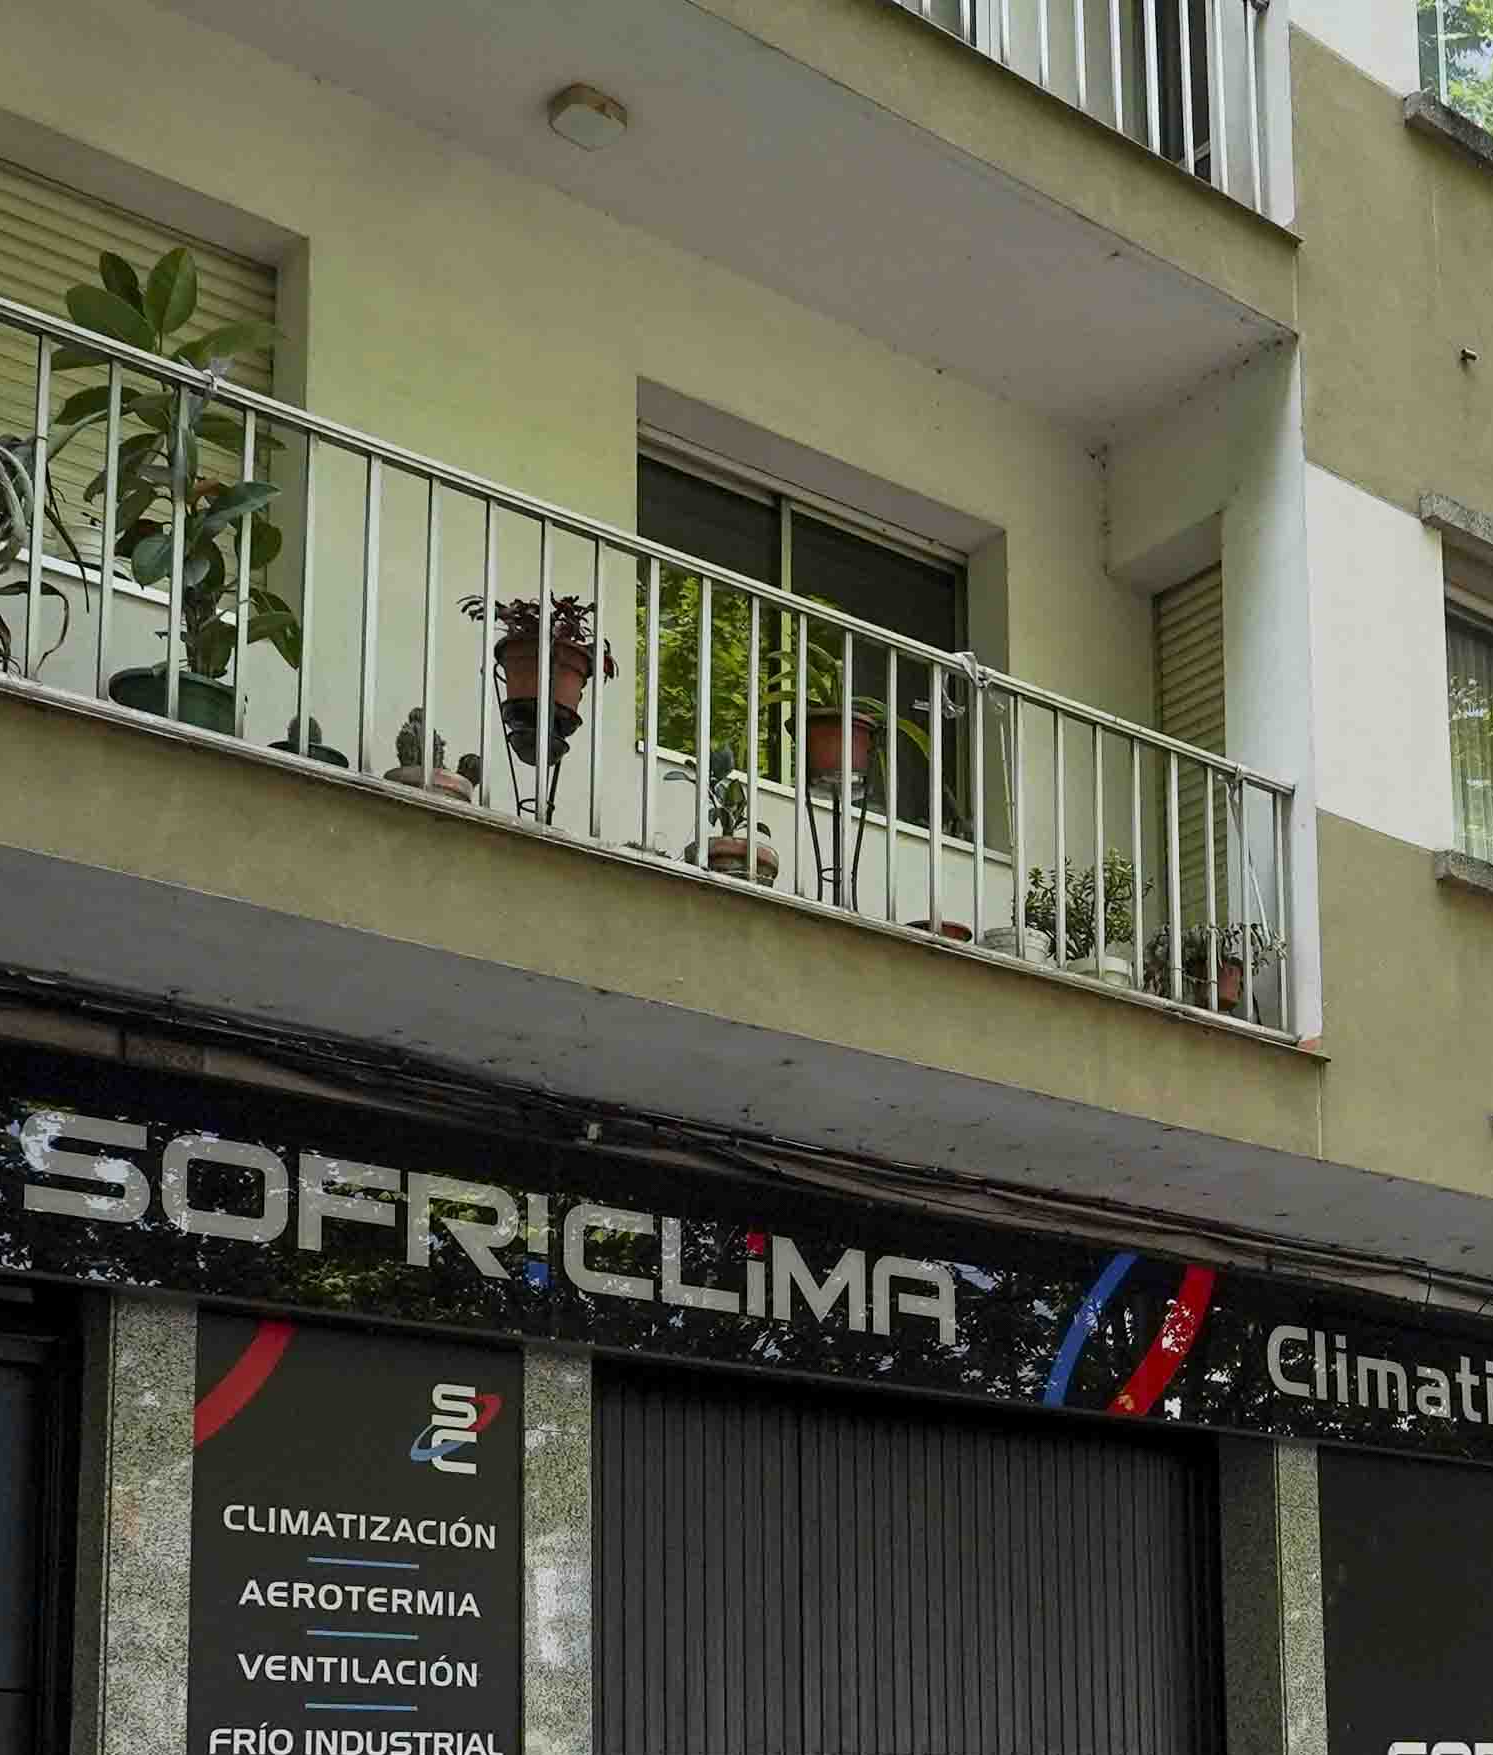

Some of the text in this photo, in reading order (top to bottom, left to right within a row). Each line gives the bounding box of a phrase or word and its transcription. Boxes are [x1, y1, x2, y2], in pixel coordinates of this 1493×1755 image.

[223, 1504, 496, 1549] CLIMATIZACIÓN
[238, 1579, 481, 1618] AEROTERMIA
[237, 1653, 478, 1688] VENTILACIÓN
